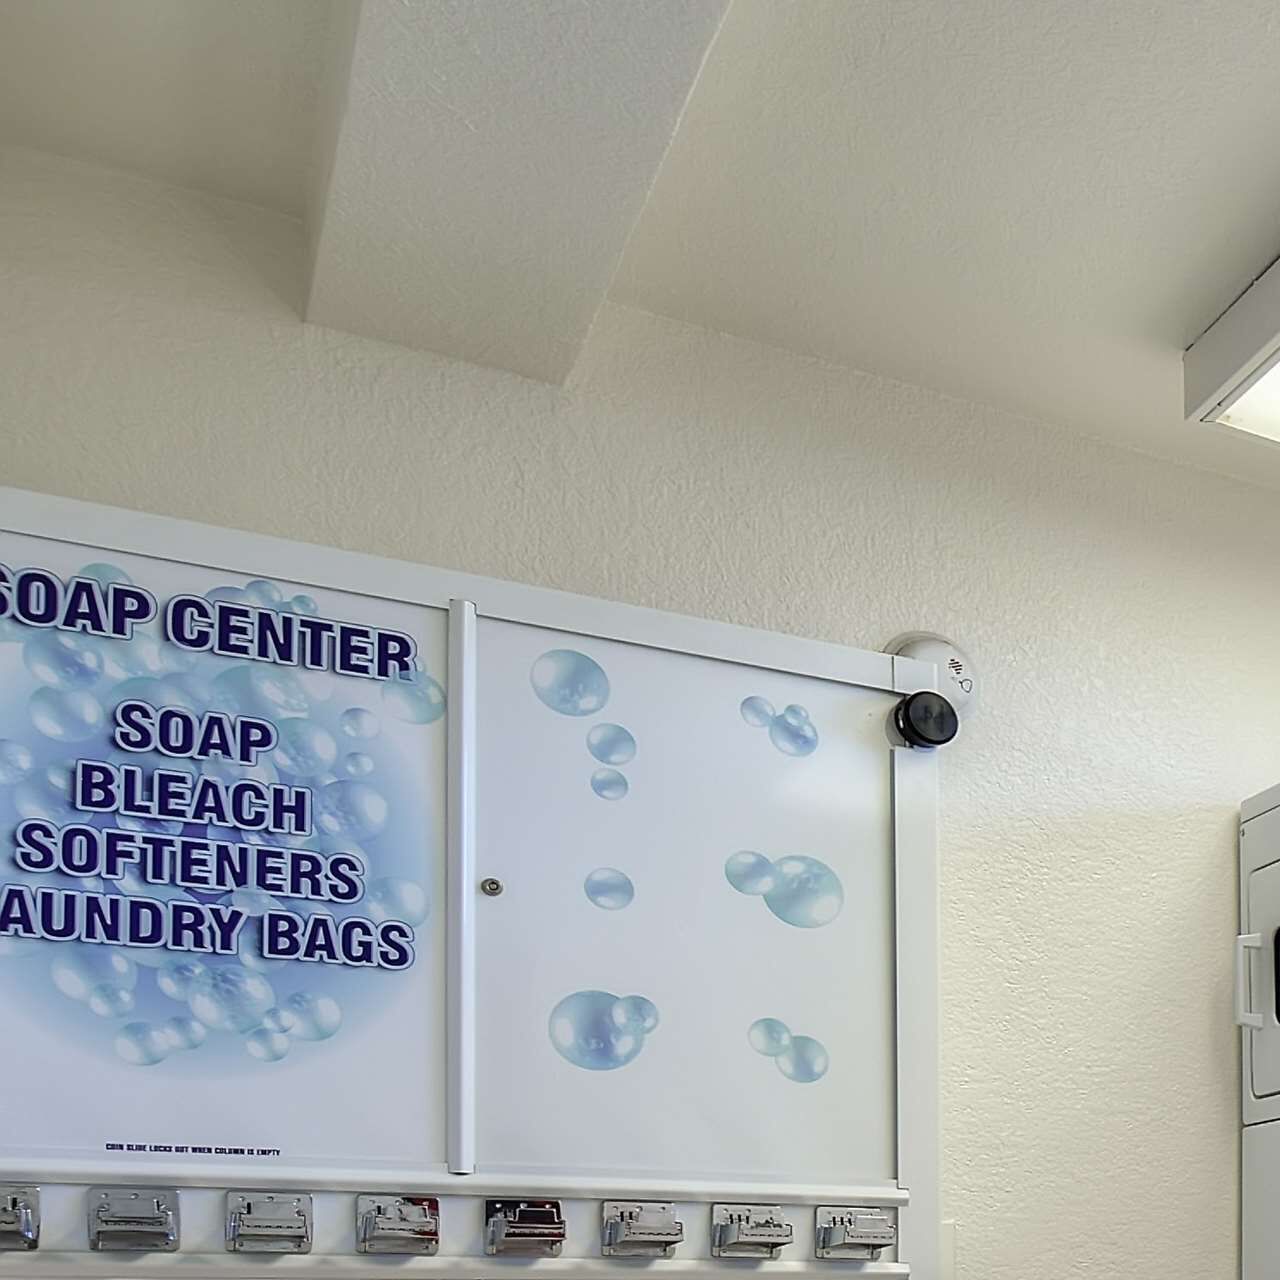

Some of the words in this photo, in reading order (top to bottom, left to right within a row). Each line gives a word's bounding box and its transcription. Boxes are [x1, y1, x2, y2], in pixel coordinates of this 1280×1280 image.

[0, 566, 150, 635] OAP
[171, 598, 417, 680] CENTER
[118, 703, 273, 762] SOAP
[80, 764, 307, 832] BLEACH
[19, 827, 362, 900] SOFTENERS
[0, 889, 243, 951] AUNDRY
[267, 913, 411, 967] BAGS
[106, 1143, 124, 1151] COIN
[191, 1146, 212, 1154] WHEN
[214, 1147, 245, 1155] COLUMN
